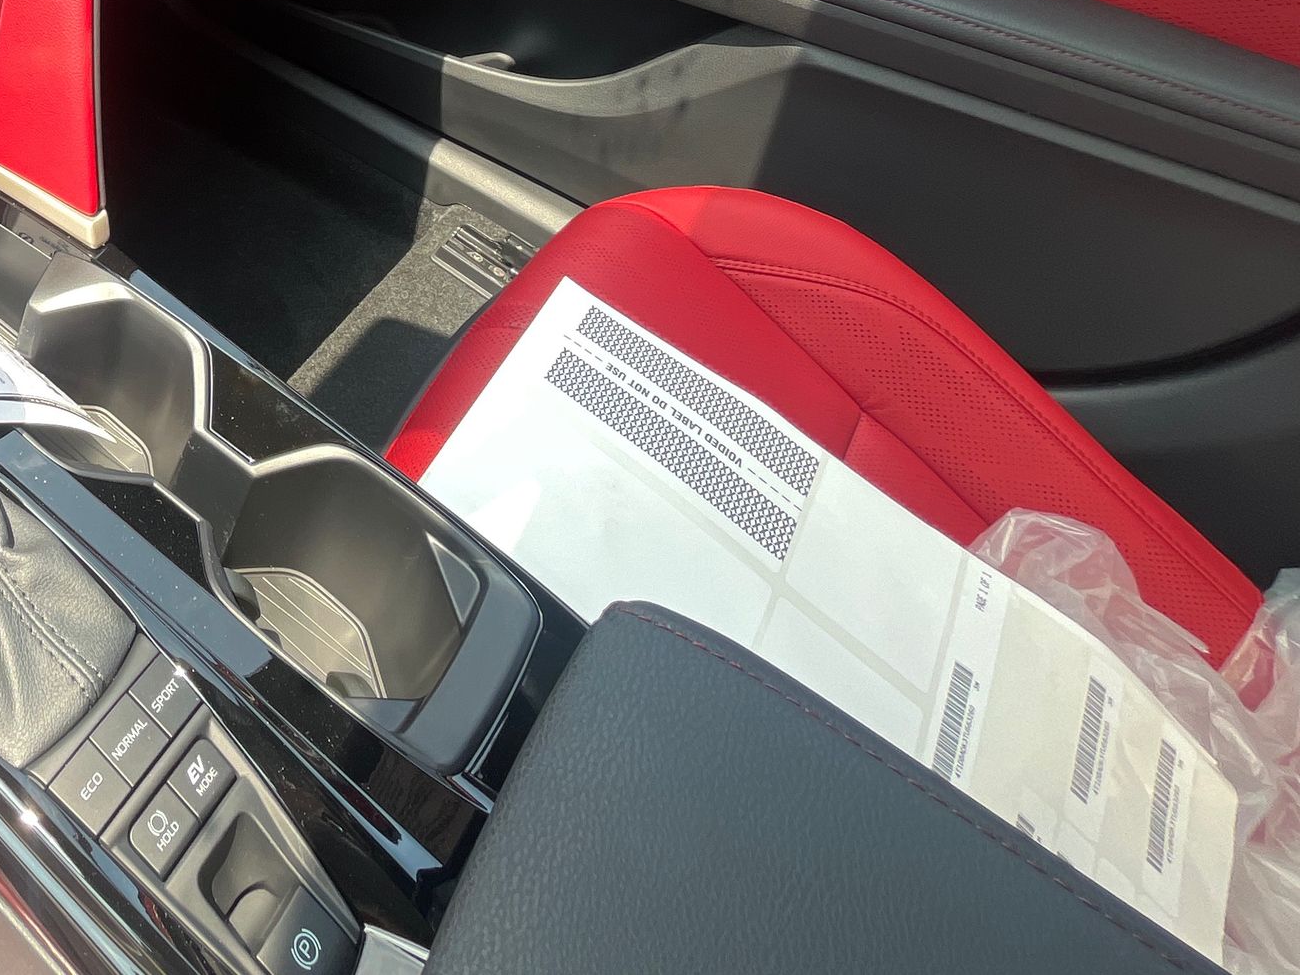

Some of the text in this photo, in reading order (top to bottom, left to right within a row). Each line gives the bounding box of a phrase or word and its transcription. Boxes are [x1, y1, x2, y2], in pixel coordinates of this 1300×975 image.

[604, 362, 743, 469] VOIDED LABEL DO NOT USE
[980, 576, 990, 589] OF
[974, 593, 987, 613] PAGE
[150, 677, 181, 714] SPORT
[110, 717, 149, 763] NORMAL
[186, 754, 207, 785] EV
[195, 766, 219, 798] MODE
[80, 771, 104, 802] ECO
[156, 821, 181, 853] HOLD
